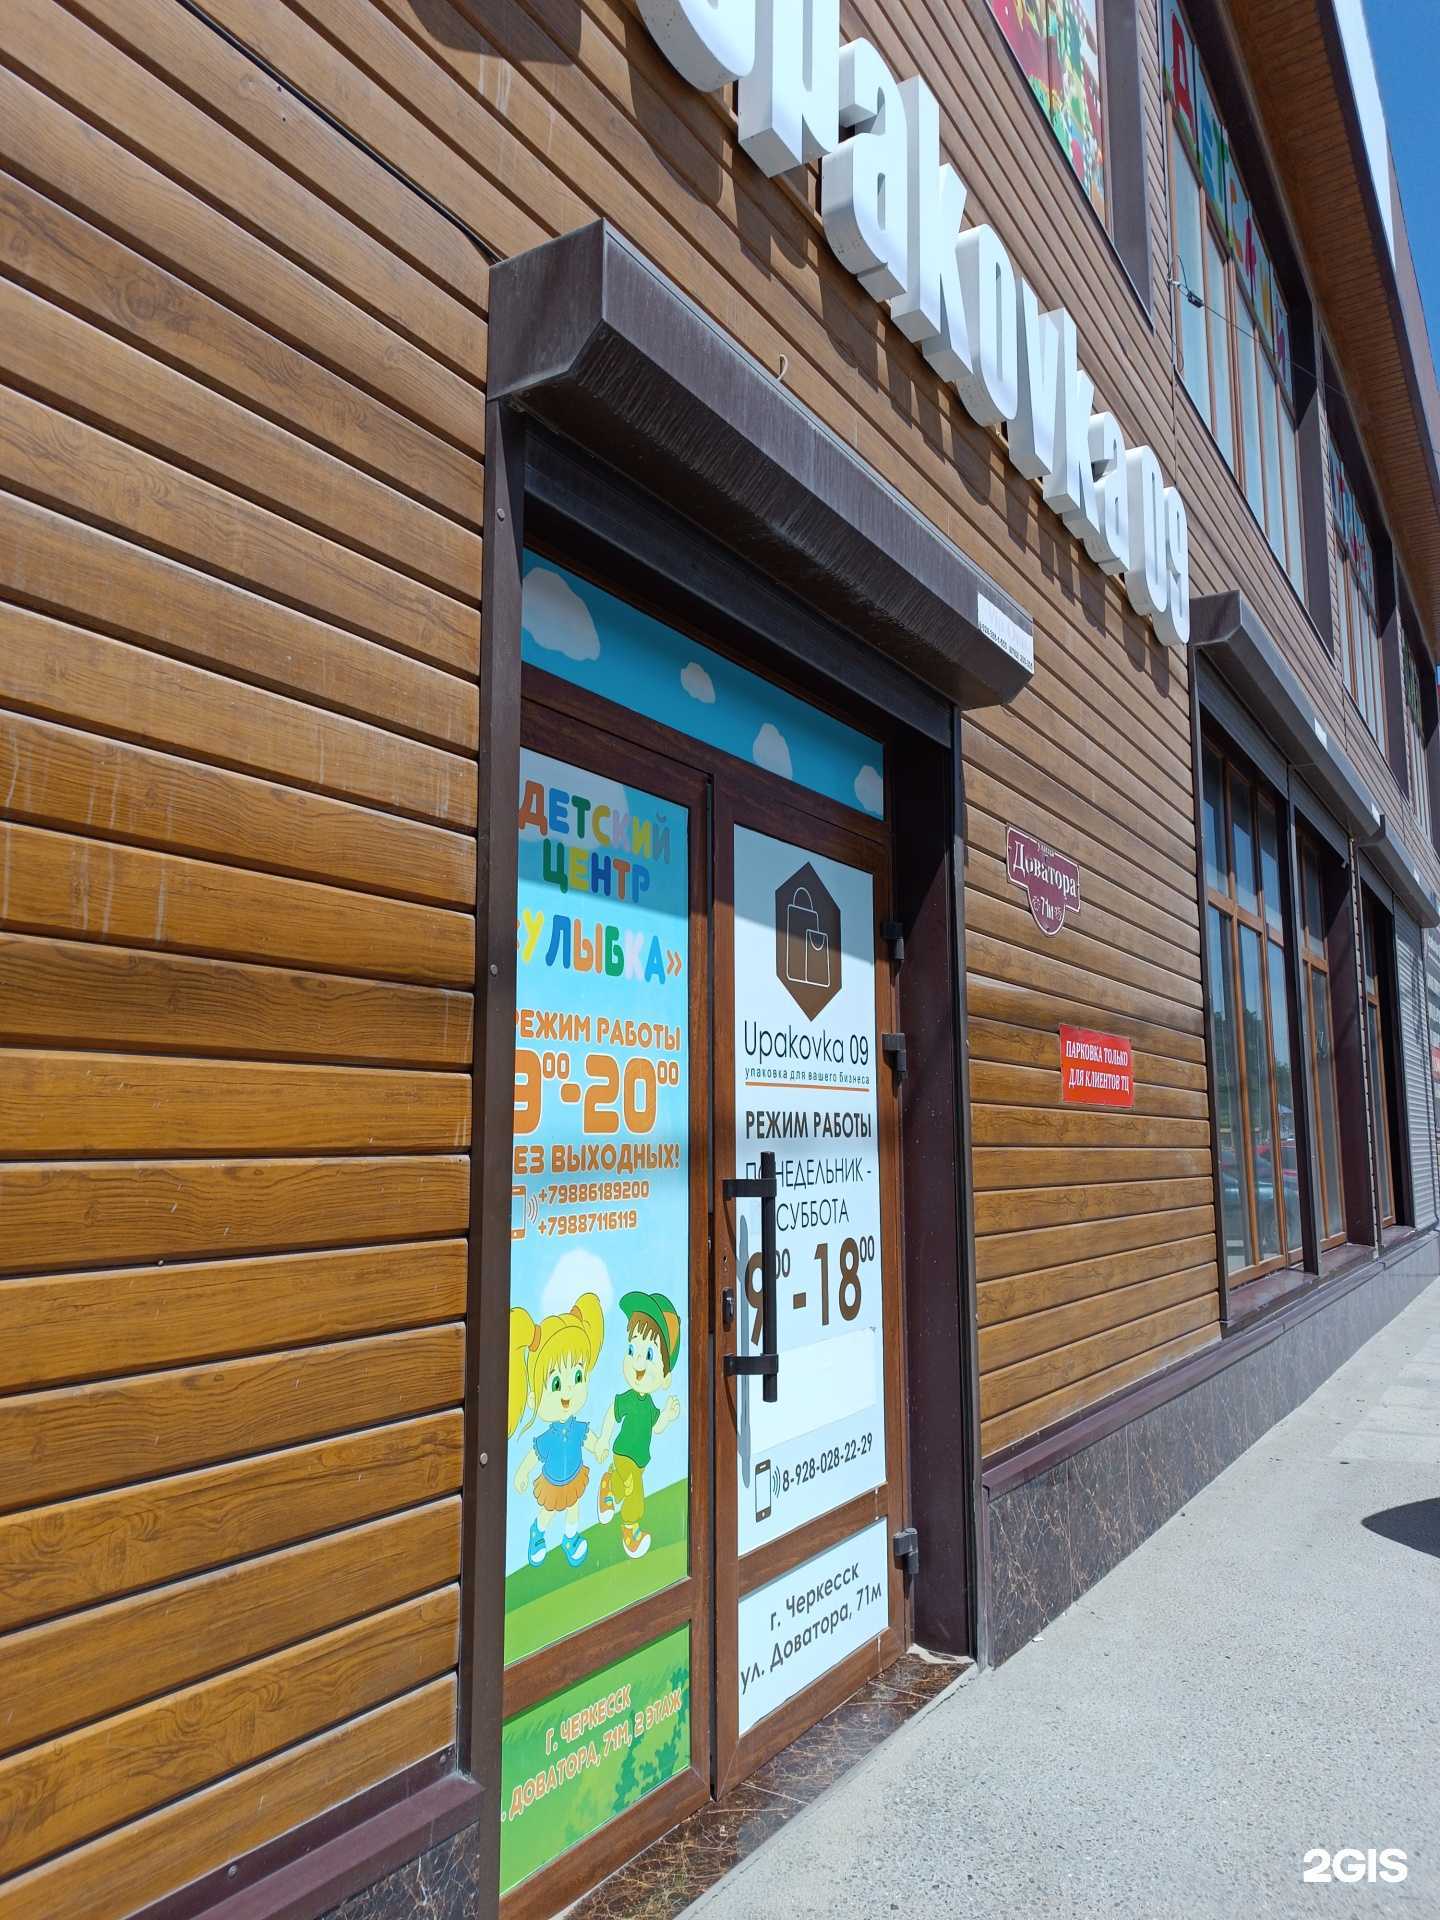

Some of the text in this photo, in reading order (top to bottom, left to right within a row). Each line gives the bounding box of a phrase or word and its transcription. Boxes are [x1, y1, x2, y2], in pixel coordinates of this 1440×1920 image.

[1124, 445, 1190, 646] 09
[519, 780, 671, 864] ДЕТСКИЙ
[542, 838, 651, 903] ЦЕНТР
[1012, 840, 1077, 900] Доватора
[514, 907, 682, 985] УЛЫБКА»
[514, 1008, 681, 1051] ЕЖИМ РАБОТЫ
[744, 1020, 869, 1066] Upakovka 09
[1065, 1040, 1128, 1067] ПАРКОВКА ТОЛЬКО
[745, 1067, 870, 1085] упаковка для вашего бизнеса
[1068, 1068, 1130, 1095] ДЛЯ КЛИЕНТОВ ТЦ
[745, 1110, 872, 1139] РЕЖИМ РАБОТЫ
[513, 1143, 680, 1175] ЕЗ ВЫХОДНЫХ!
[745, 1157, 863, 1190] ПНЕДЕЛЬНИК
[538, 1180, 650, 1205] +79886189200
[776, 1198, 849, 1231] СУББОТА
[782, 1432, 873, 1492] 8-928-028-22-29
[770, 1562, 859, 1631] г. Черкесск
[740, 1583, 882, 1695] ул. Доватора, 71м
[560, 1684, 631, 1743] ЧЕРКЕССК
[508, 1741, 600, 1822] ДОВАТОРА,
[645, 1687, 682, 1730] ЭТАЖ
